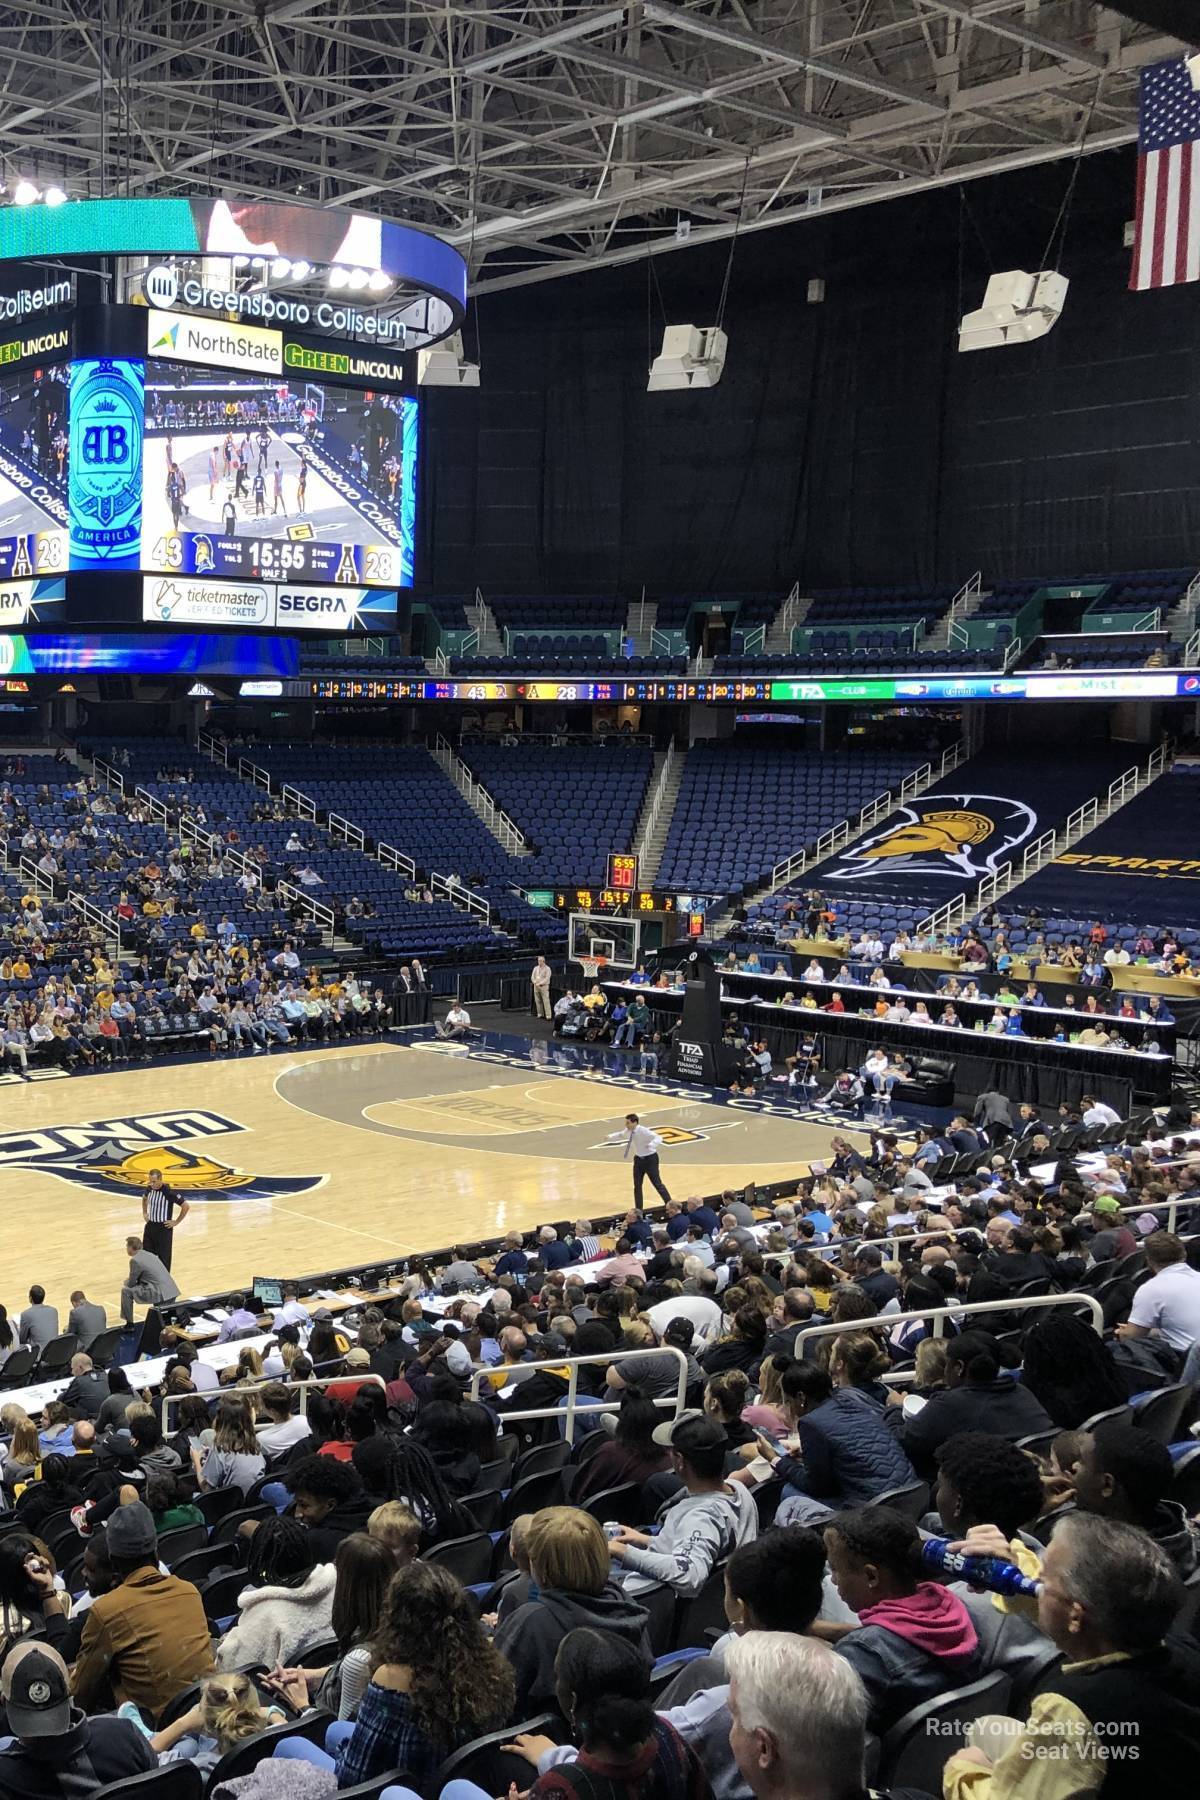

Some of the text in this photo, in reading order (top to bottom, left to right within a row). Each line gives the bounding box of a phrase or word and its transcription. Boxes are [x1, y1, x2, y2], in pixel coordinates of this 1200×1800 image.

[183, 280, 407, 339] Greensboro Coliseum
[21, 330, 68, 357] LINCOLN
[188, 329, 280, 362] NorthState
[284, 343, 403, 381] GREEN LINCOLN
[296, 444, 361, 500] Greensboro
[77, 529, 132, 542] AMERICA
[38, 538, 61, 568] 28
[152, 537, 183, 567] 43
[249, 541, 304, 570] 15:55
[365, 552, 392, 580] 28
[279, 594, 347, 613] SEGRA
[225, 607, 257, 617] TICKETS
[354, 685, 362, 694] 13
[376, 685, 386, 694] 14
[401, 686, 410, 695] 21
[468, 686, 486, 700] 43
[558, 686, 577, 700] 28
[628, 687, 634, 696] 0
[688, 686, 695, 696] 2
[716, 686, 728, 696] 20
[789, 684, 867, 699] TFA CLUB
[614, 857, 635, 869] 15:55
[614, 868, 631, 886] 30
[578, 897, 592, 907] 43
[640, 900, 654, 910] 28
[678, 1042, 704, 1056] TFA
[676, 1061, 703, 1070] FINANCIAL
[677, 1068, 702, 1076] ADVISORS
[469, 1051, 919, 1141] Greensboro Coliseu
